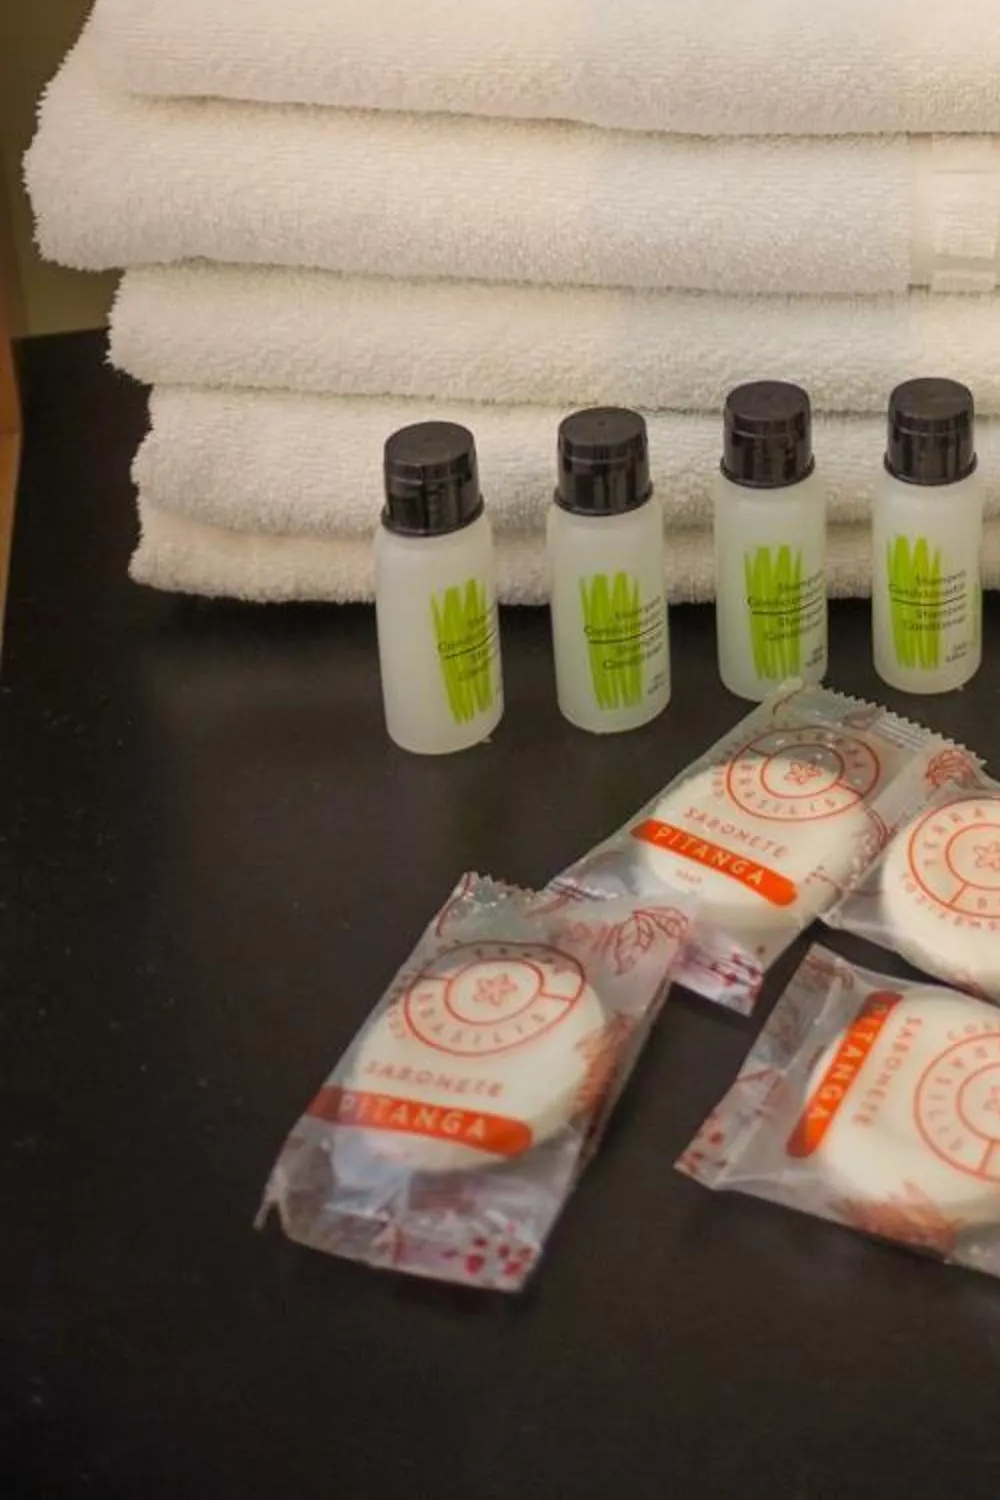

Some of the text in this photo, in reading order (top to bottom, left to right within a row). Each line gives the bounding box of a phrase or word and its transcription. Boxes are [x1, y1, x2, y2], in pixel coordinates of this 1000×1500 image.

[653, 825, 766, 886] PITANGA
[366, 1060, 504, 1098] SABONETE
[808, 1002, 890, 1121] PITANGA
[340, 1092, 488, 1140] PITANGA
